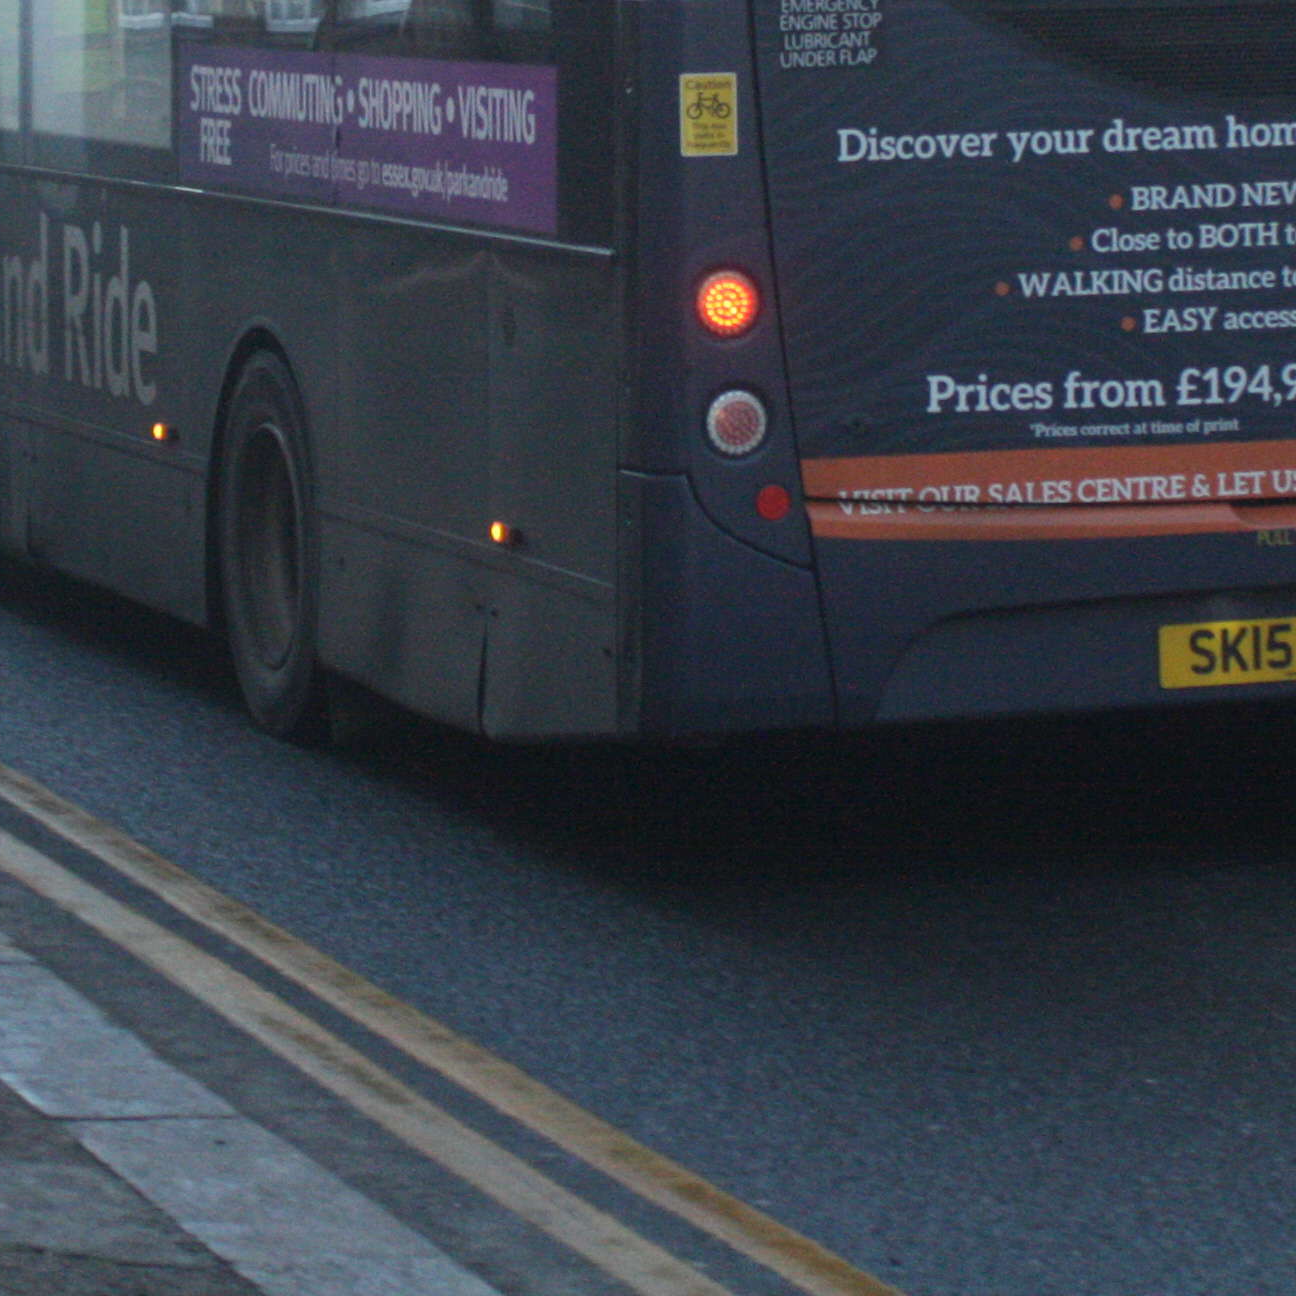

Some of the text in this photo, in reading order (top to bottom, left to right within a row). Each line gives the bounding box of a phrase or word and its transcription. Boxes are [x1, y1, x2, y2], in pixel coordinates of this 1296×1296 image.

[780, 12, 882, 31] ENGINE STOP
[784, 31, 870, 50] LUBRICANT
[780, 48, 877, 68] UNDER FLAP
[190, 64, 536, 145] STRESS COMMUTING SHOPPING VISITING
[199, 117, 232, 166] FREE
[837, 126, 997, 162] Discover
[1007, 128, 1094, 163] your
[1103, 119, 1218, 152] dream
[312, 149, 329, 181] and
[1131, 183, 1236, 211] BRAND
[1091, 227, 1160, 253] Close
[1166, 228, 1193, 251] to
[1198, 222, 1279, 249] BOTH
[1017, 269, 1164, 298] WALKING
[1168, 267, 1276, 292] distance
[64, 220, 157, 405] Ride
[1142, 306, 1219, 334] EASY
[926, 374, 1053, 413] Prices
[1063, 371, 1166, 409] from
[1080, 422, 1130, 437] correct
[1134, 422, 1148, 435] at
[1151, 420, 1184, 434] time
[1186, 419, 1200, 433] of
[1203, 418, 1240, 435] print
[838, 488, 913, 516] VISIT
[919, 485, 980, 512] OUR
[988, 480, 1072, 506] SALES
[1077, 475, 1186, 503] CENTRE
[1192, 474, 1211, 497] &
[1217, 471, 1266, 496] LET
[1257, 529, 1292, 546] PULL
[1189, 624, 1292, 675] SK15
